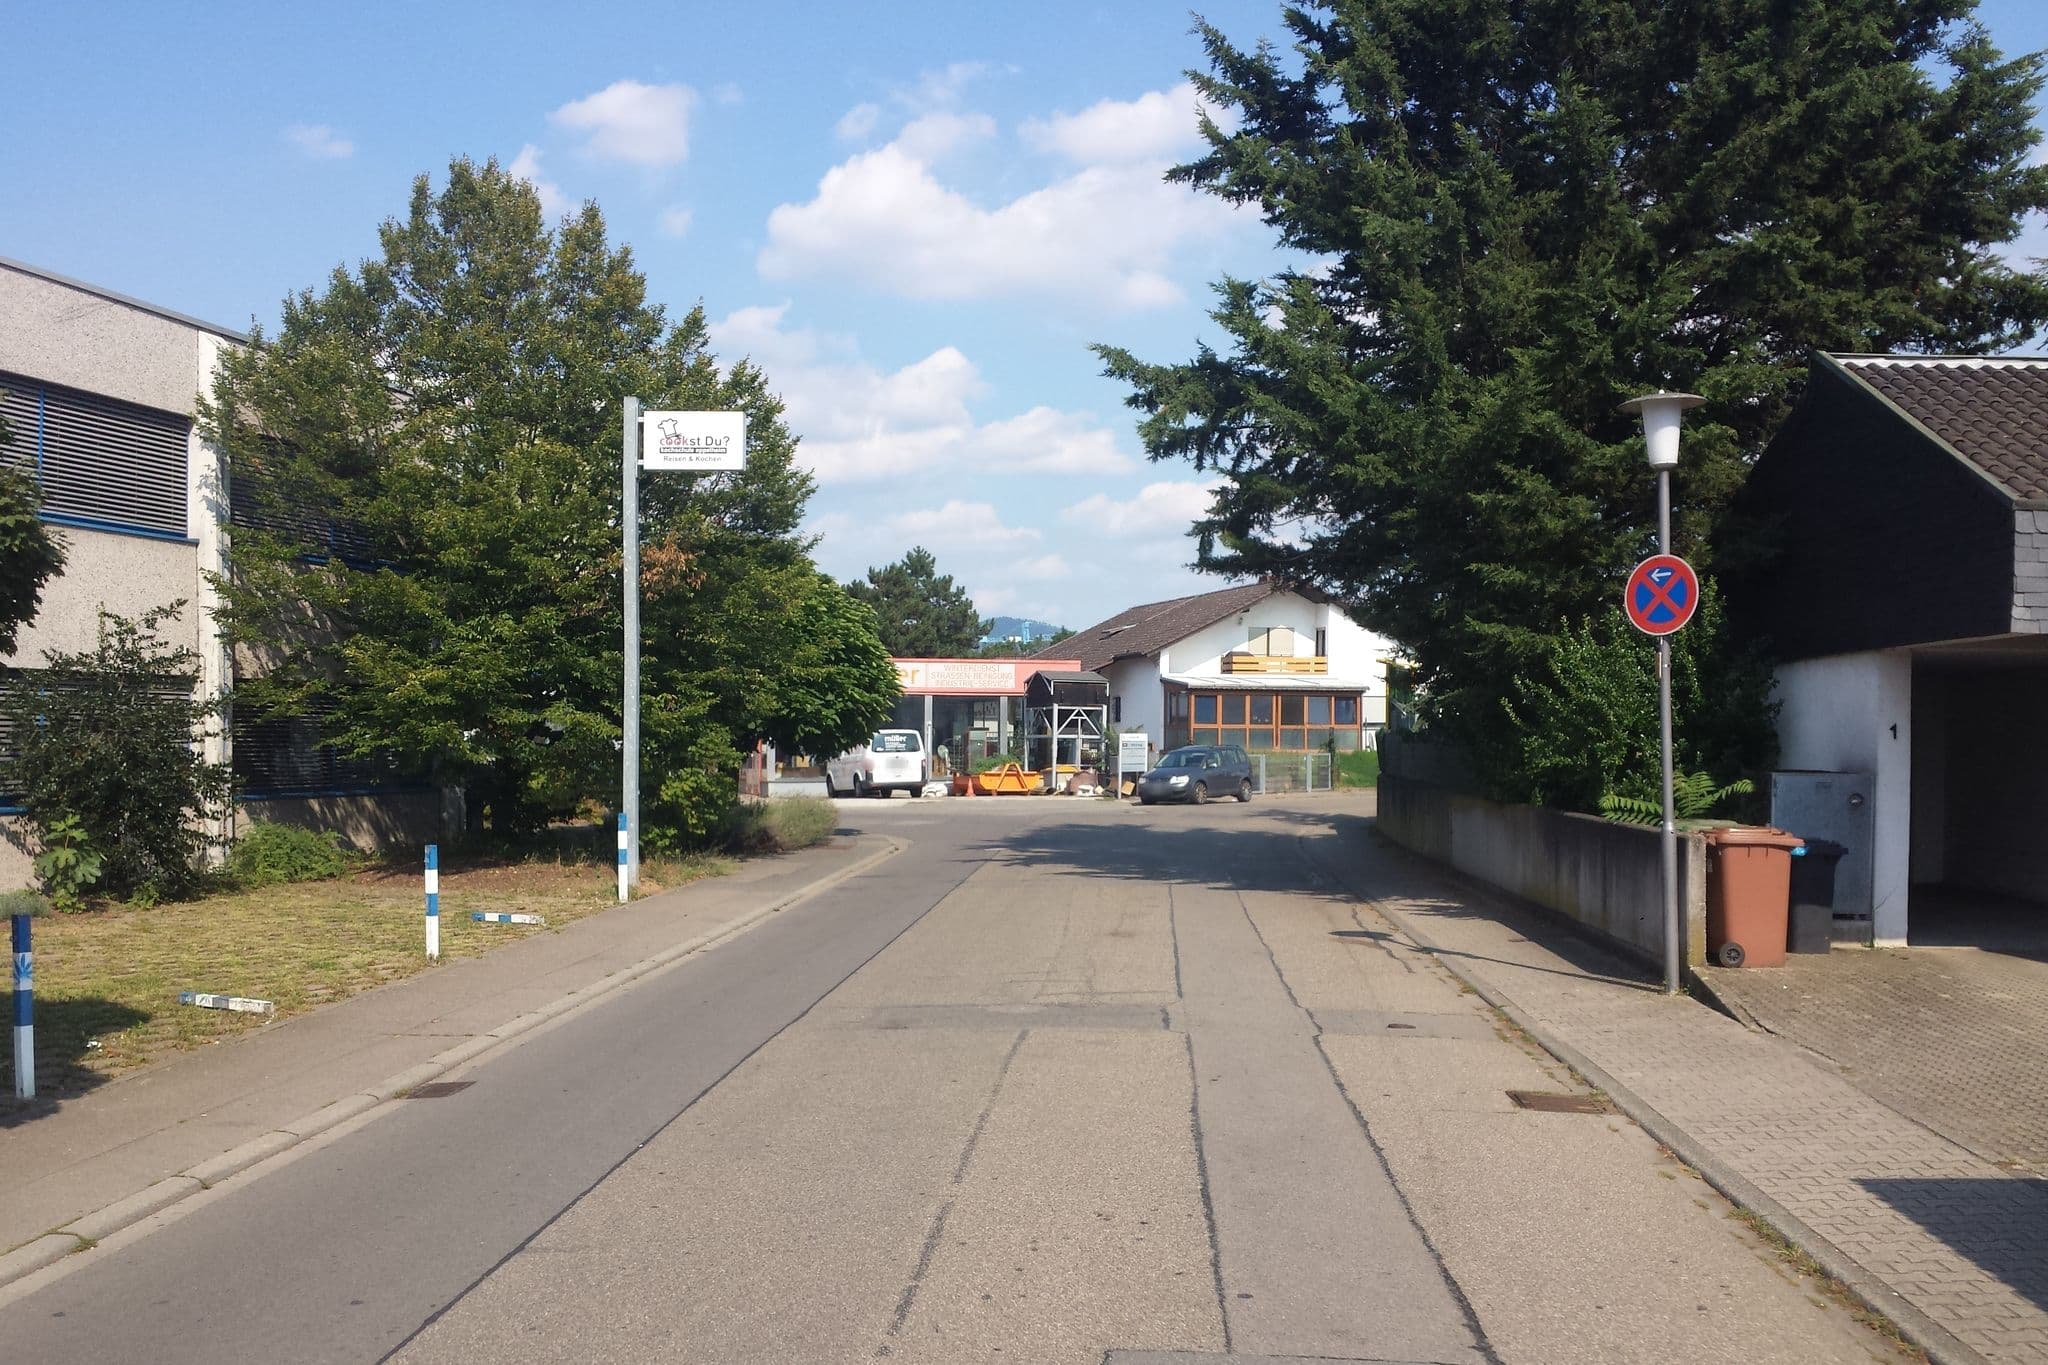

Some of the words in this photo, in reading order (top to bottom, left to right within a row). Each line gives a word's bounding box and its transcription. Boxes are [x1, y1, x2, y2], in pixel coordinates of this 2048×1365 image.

[705, 435, 730, 446] Du?
[943, 664, 1000, 672] WINTERDIENST
[1889, 723, 1897, 740] 1
